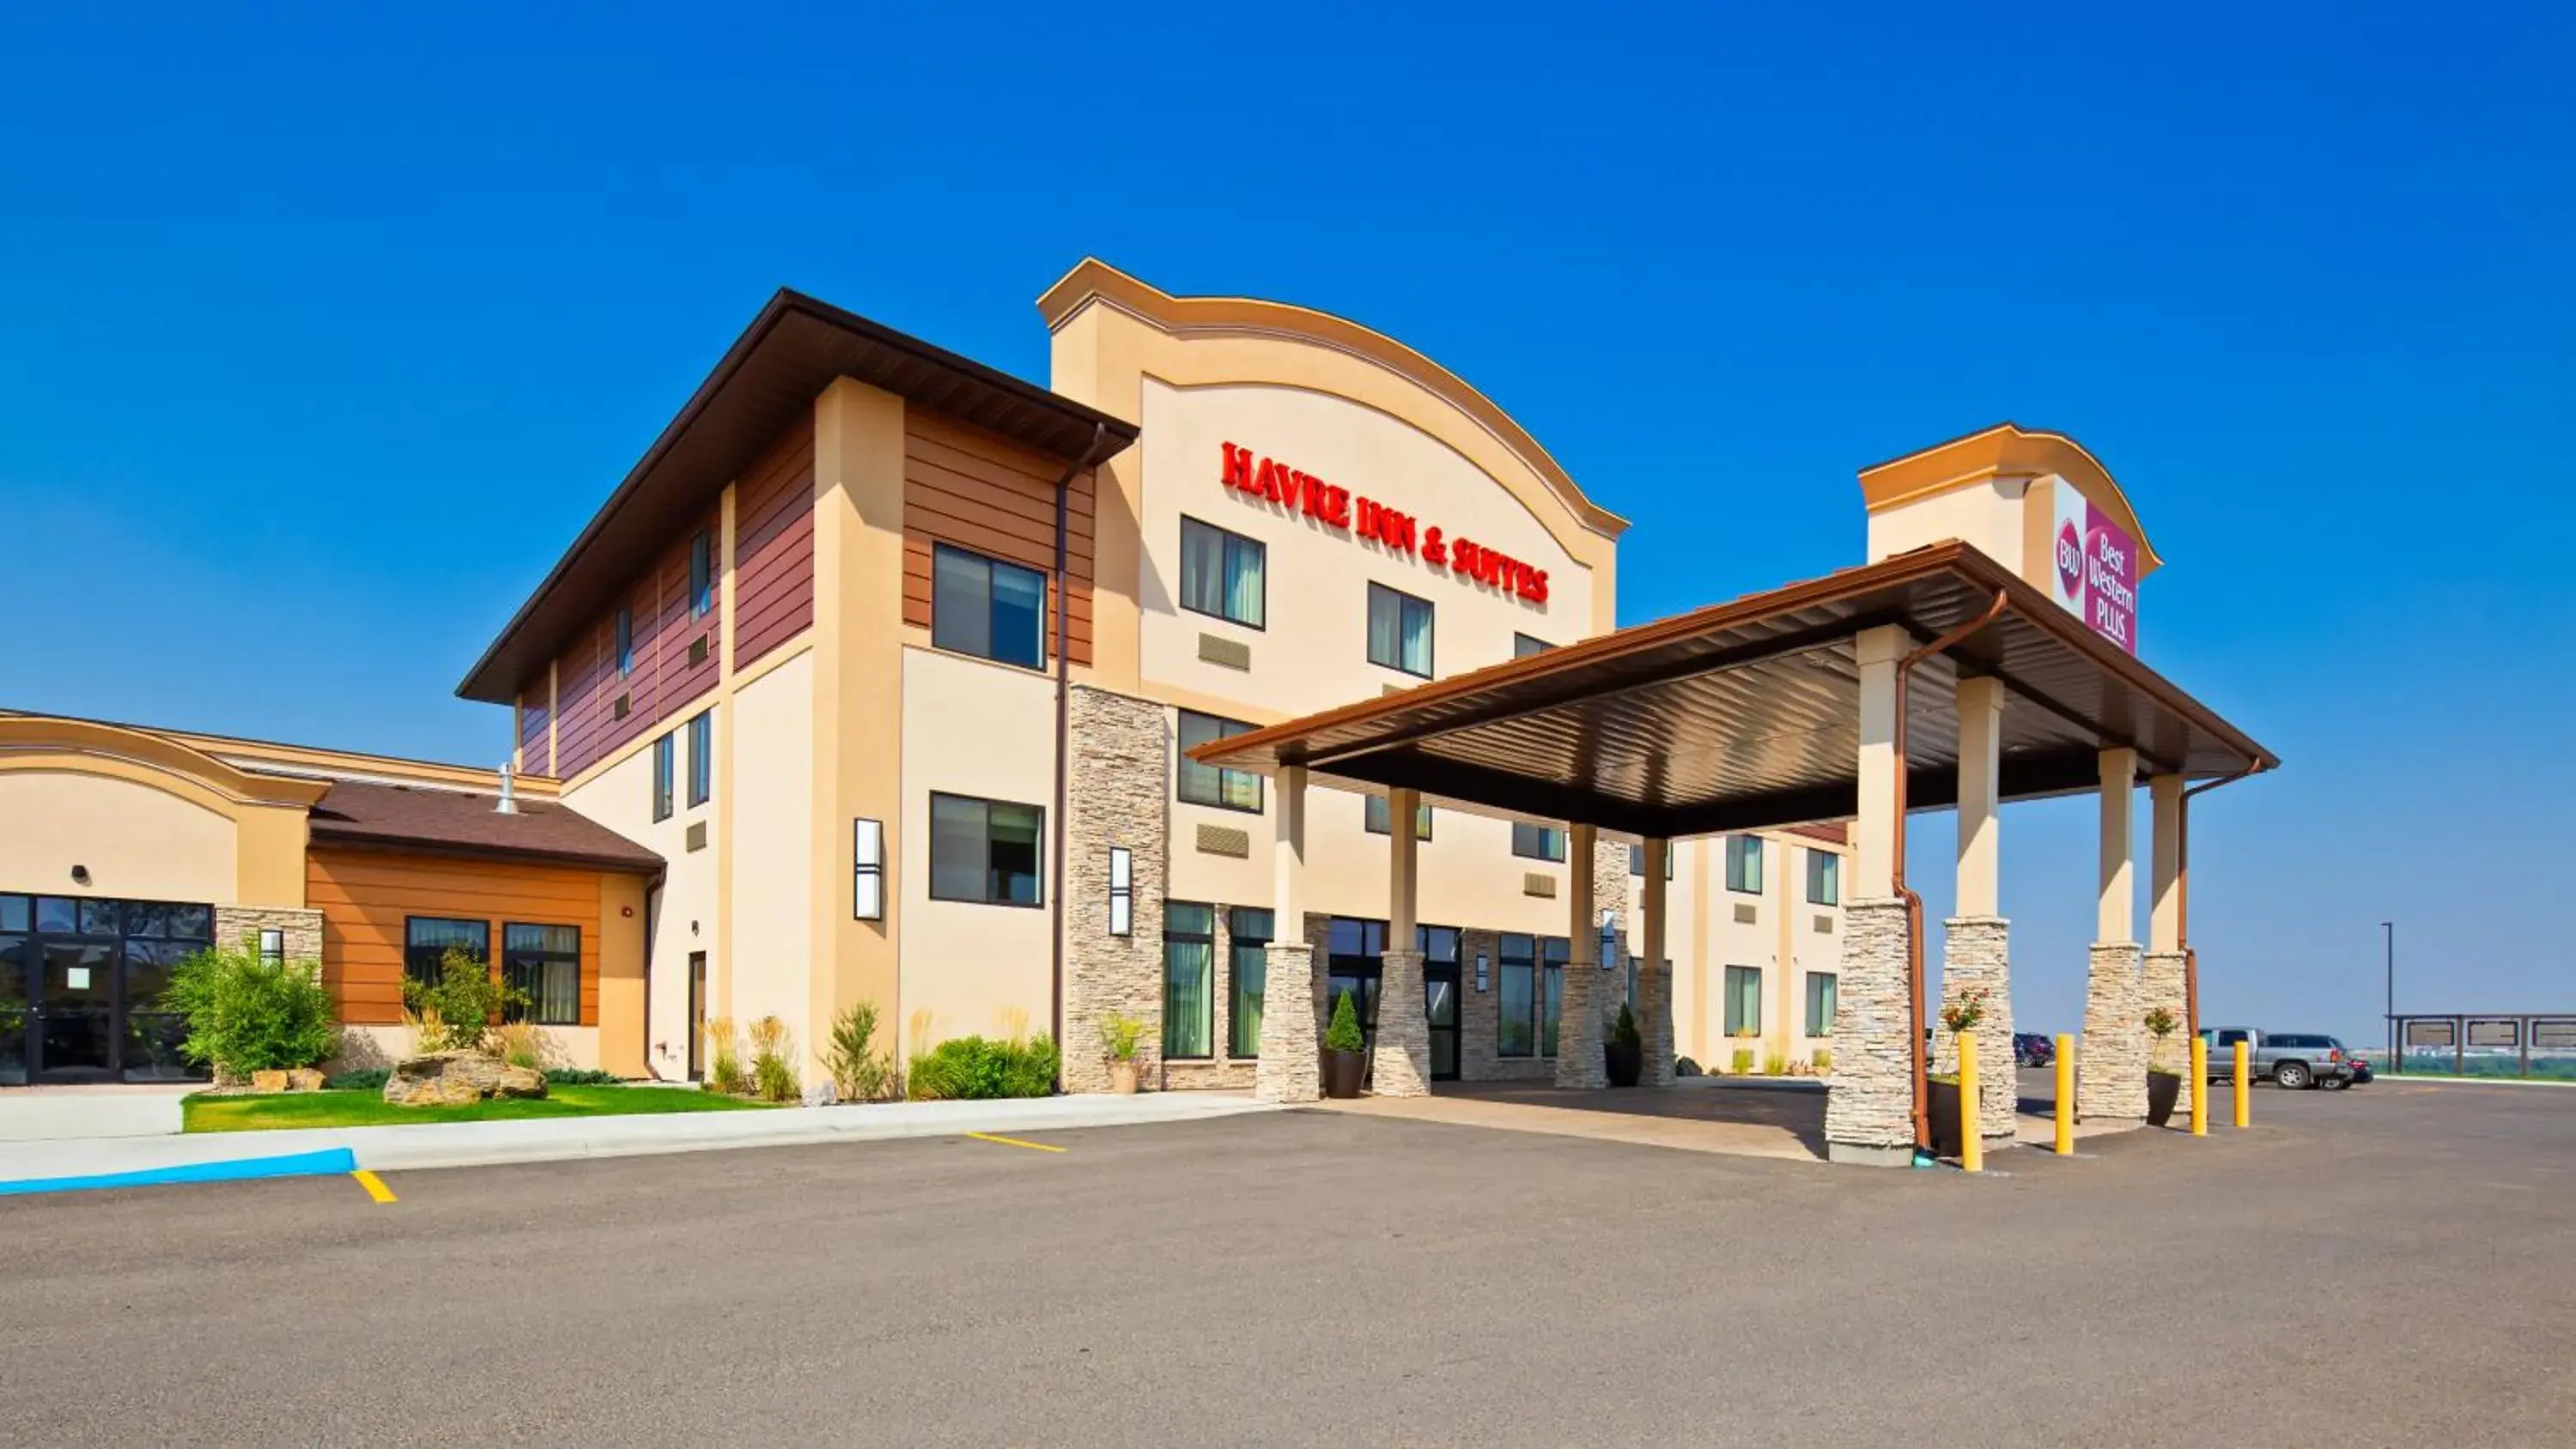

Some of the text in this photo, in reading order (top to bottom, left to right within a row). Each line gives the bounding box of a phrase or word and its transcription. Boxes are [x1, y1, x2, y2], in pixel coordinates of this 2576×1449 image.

[1221, 441, 1550, 603] HAVRE INN & SUITES
[2060, 538, 2081, 577] BW
[2099, 533, 2125, 577] Best
[2089, 555, 2134, 614] Western
[2097, 597, 2125, 641] PLUS
